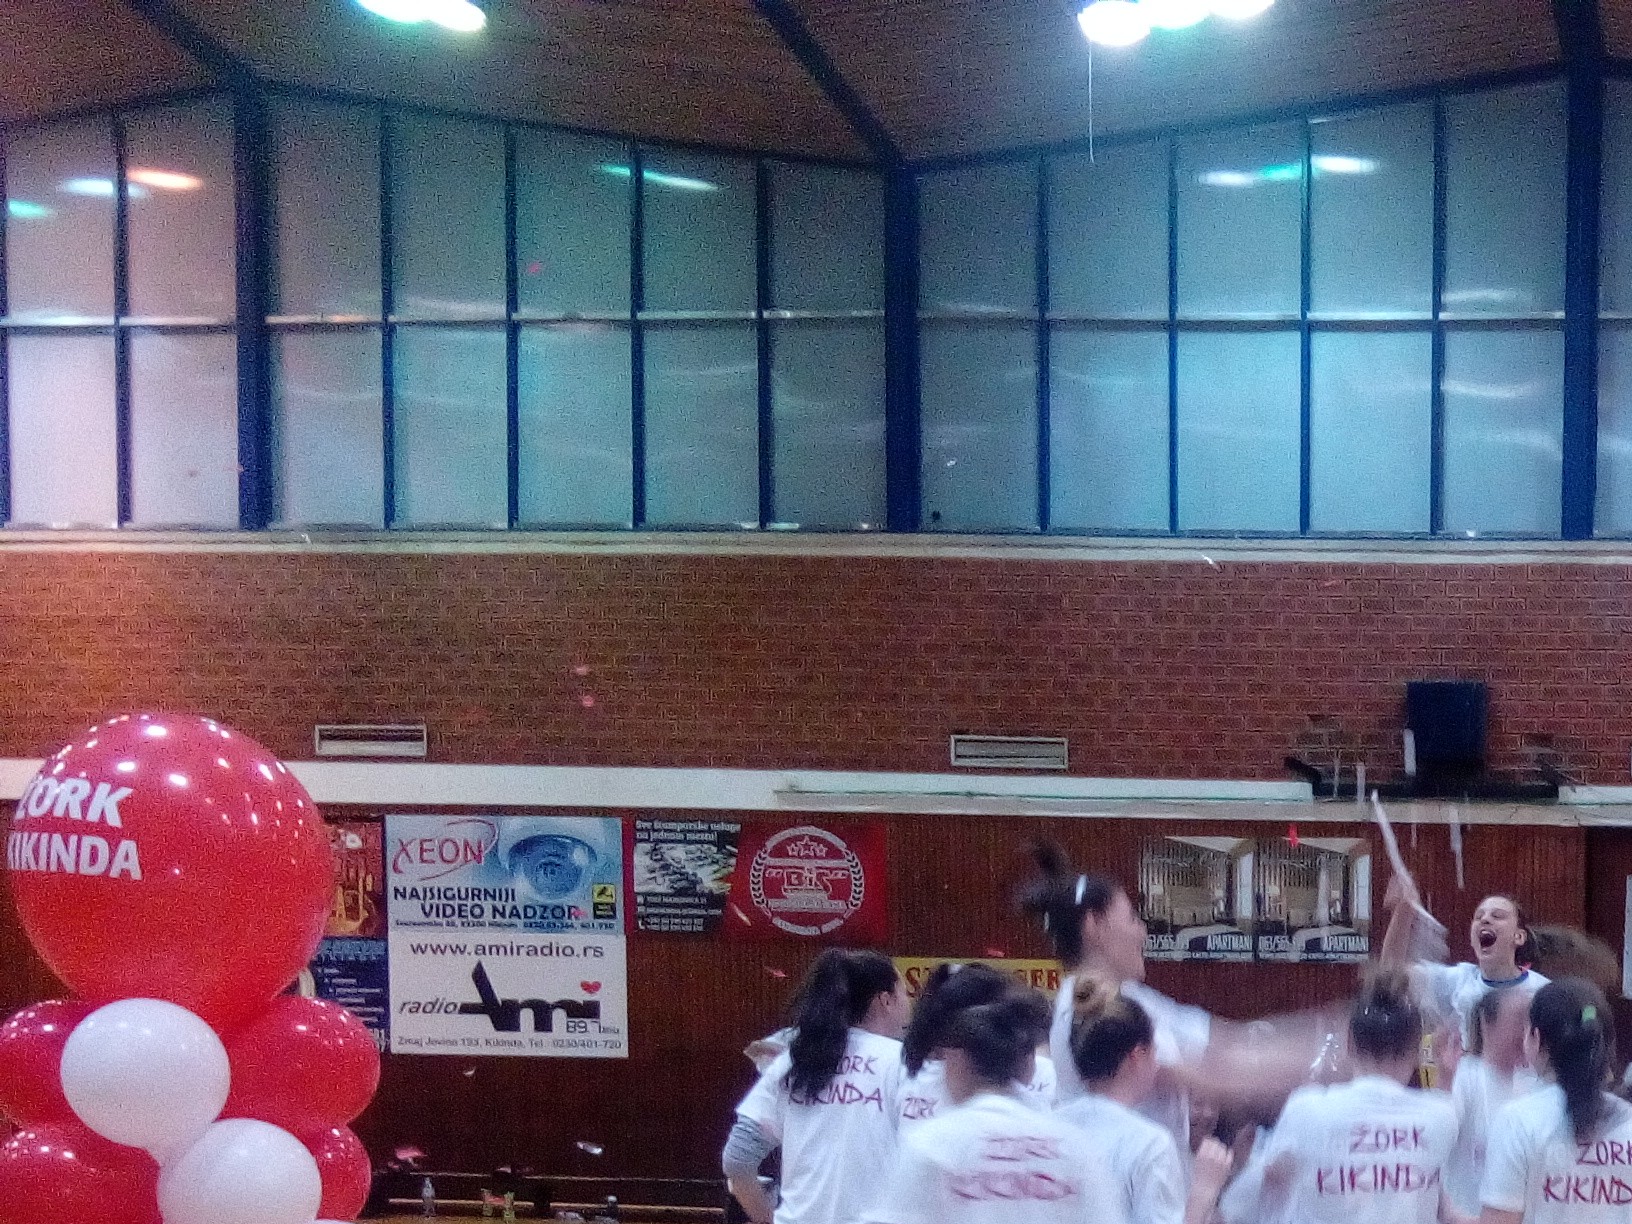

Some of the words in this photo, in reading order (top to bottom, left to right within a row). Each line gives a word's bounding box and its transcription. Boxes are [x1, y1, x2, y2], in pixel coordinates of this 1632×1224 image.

[392, 838, 484, 874] XEON
[393, 886, 516, 902] NAJSIGURNIJI
[420, 903, 485, 919] VIDEO
[492, 904, 581, 920] NADZOR
[409, 941, 605, 958] www.amiradio.rs
[399, 998, 458, 1015] radio
